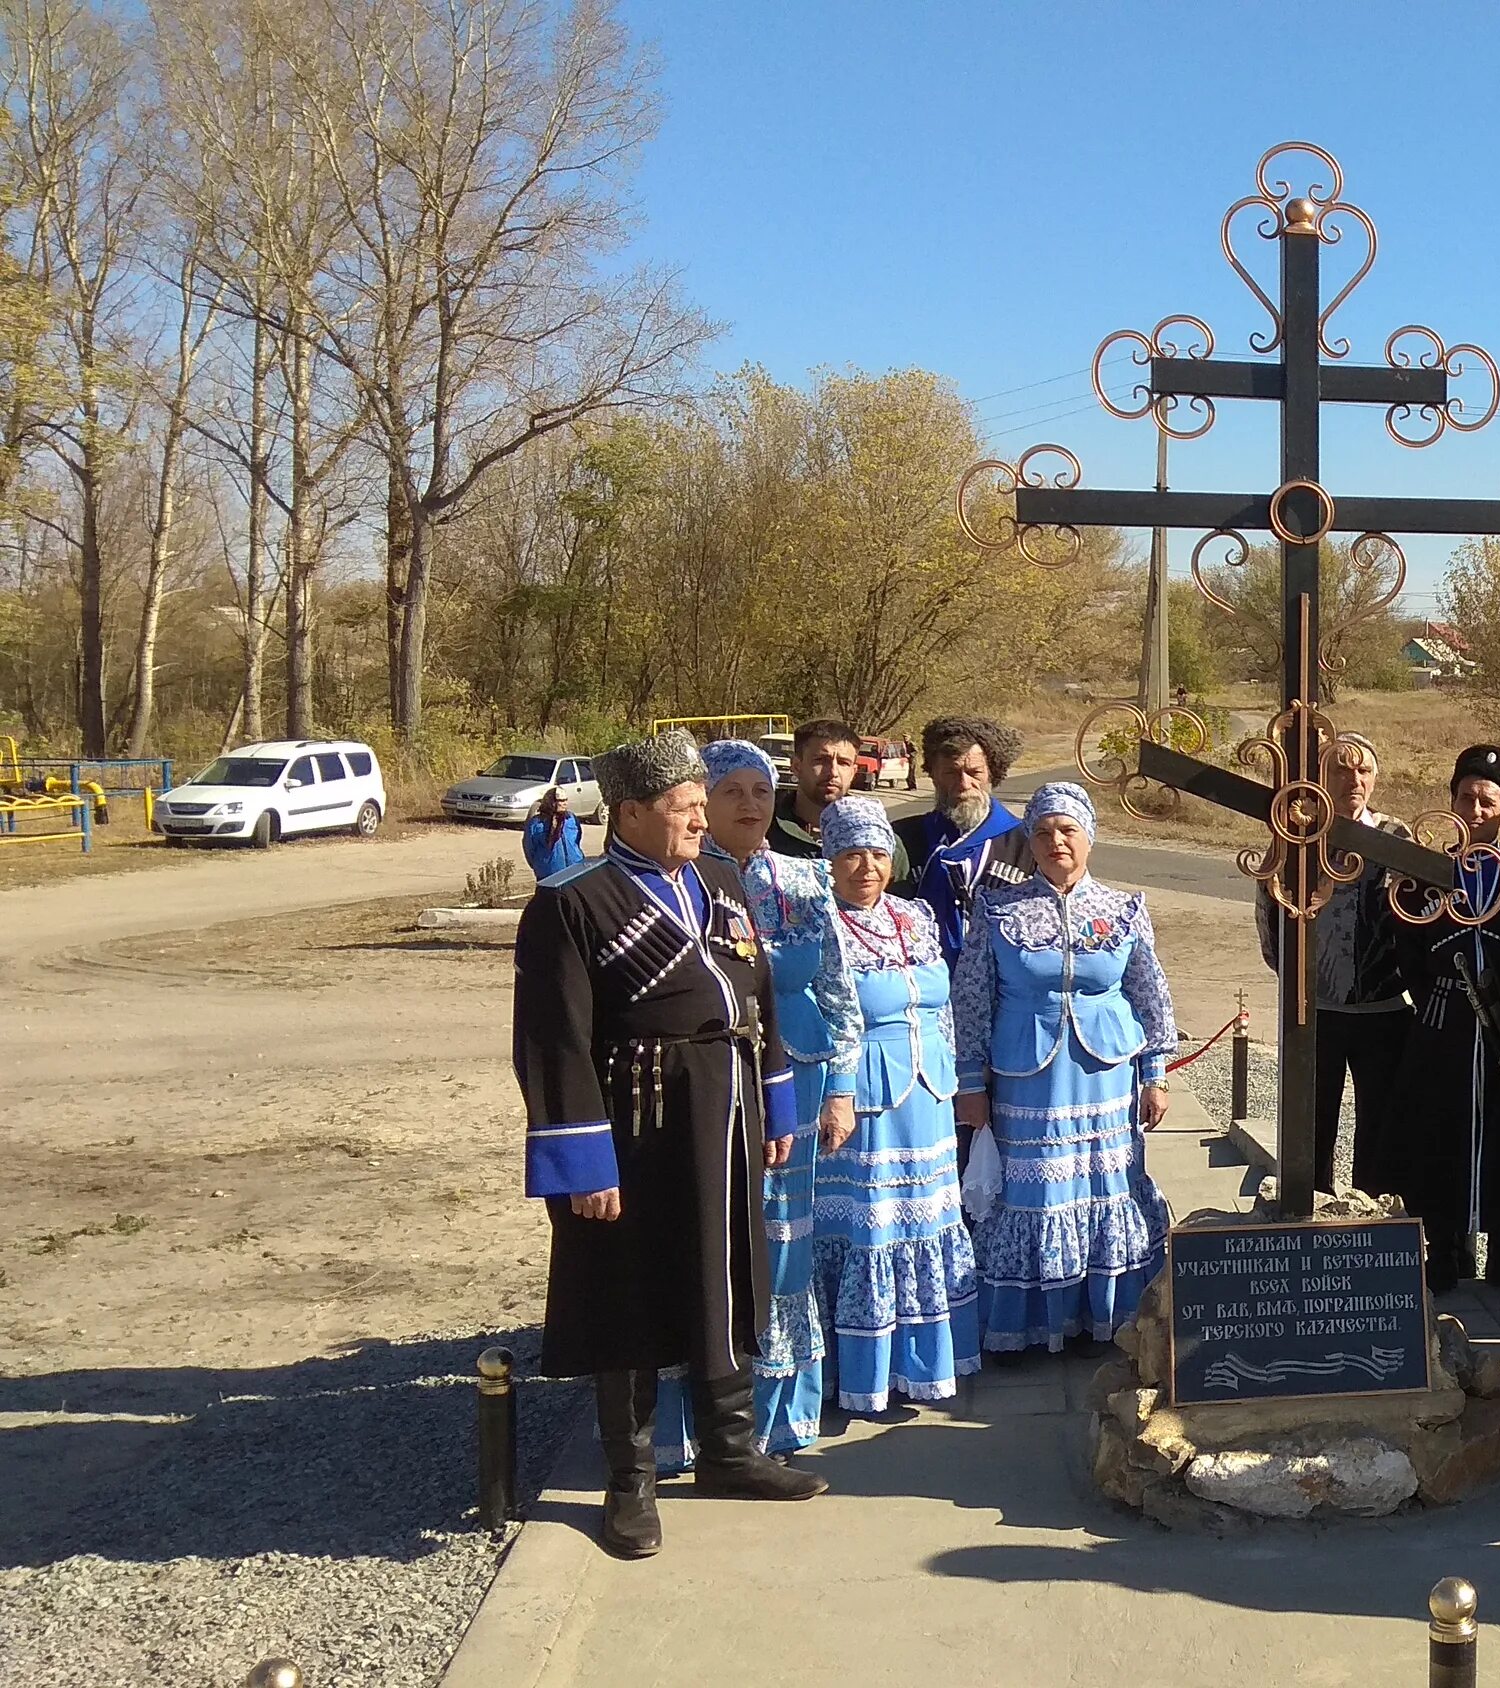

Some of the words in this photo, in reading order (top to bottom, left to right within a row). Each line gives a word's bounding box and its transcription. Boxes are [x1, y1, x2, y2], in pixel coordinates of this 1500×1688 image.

[1225, 1235, 1301, 1253] КАЗАКАМ
[1313, 1232, 1373, 1249] РОССИИ
[1176, 1256, 1290, 1277] УЧАСТНИКАМ
[1301, 1256, 1312, 1271] И
[1323, 1251, 1420, 1270] ВЕТЕРАНАМ
[1250, 1278, 1290, 1295] ВСЕХ
[1302, 1275, 1352, 1293] ВОЙСК
[1182, 1304, 1205, 1320] ОТ
[1216, 1302, 1252, 1319] ВДВ,
[1256, 1299, 1300, 1317] ВМФ,
[1304, 1292, 1419, 1314] ПОГРАНВОЙСК,
[1201, 1321, 1285, 1342] ТЕРСКОГО
